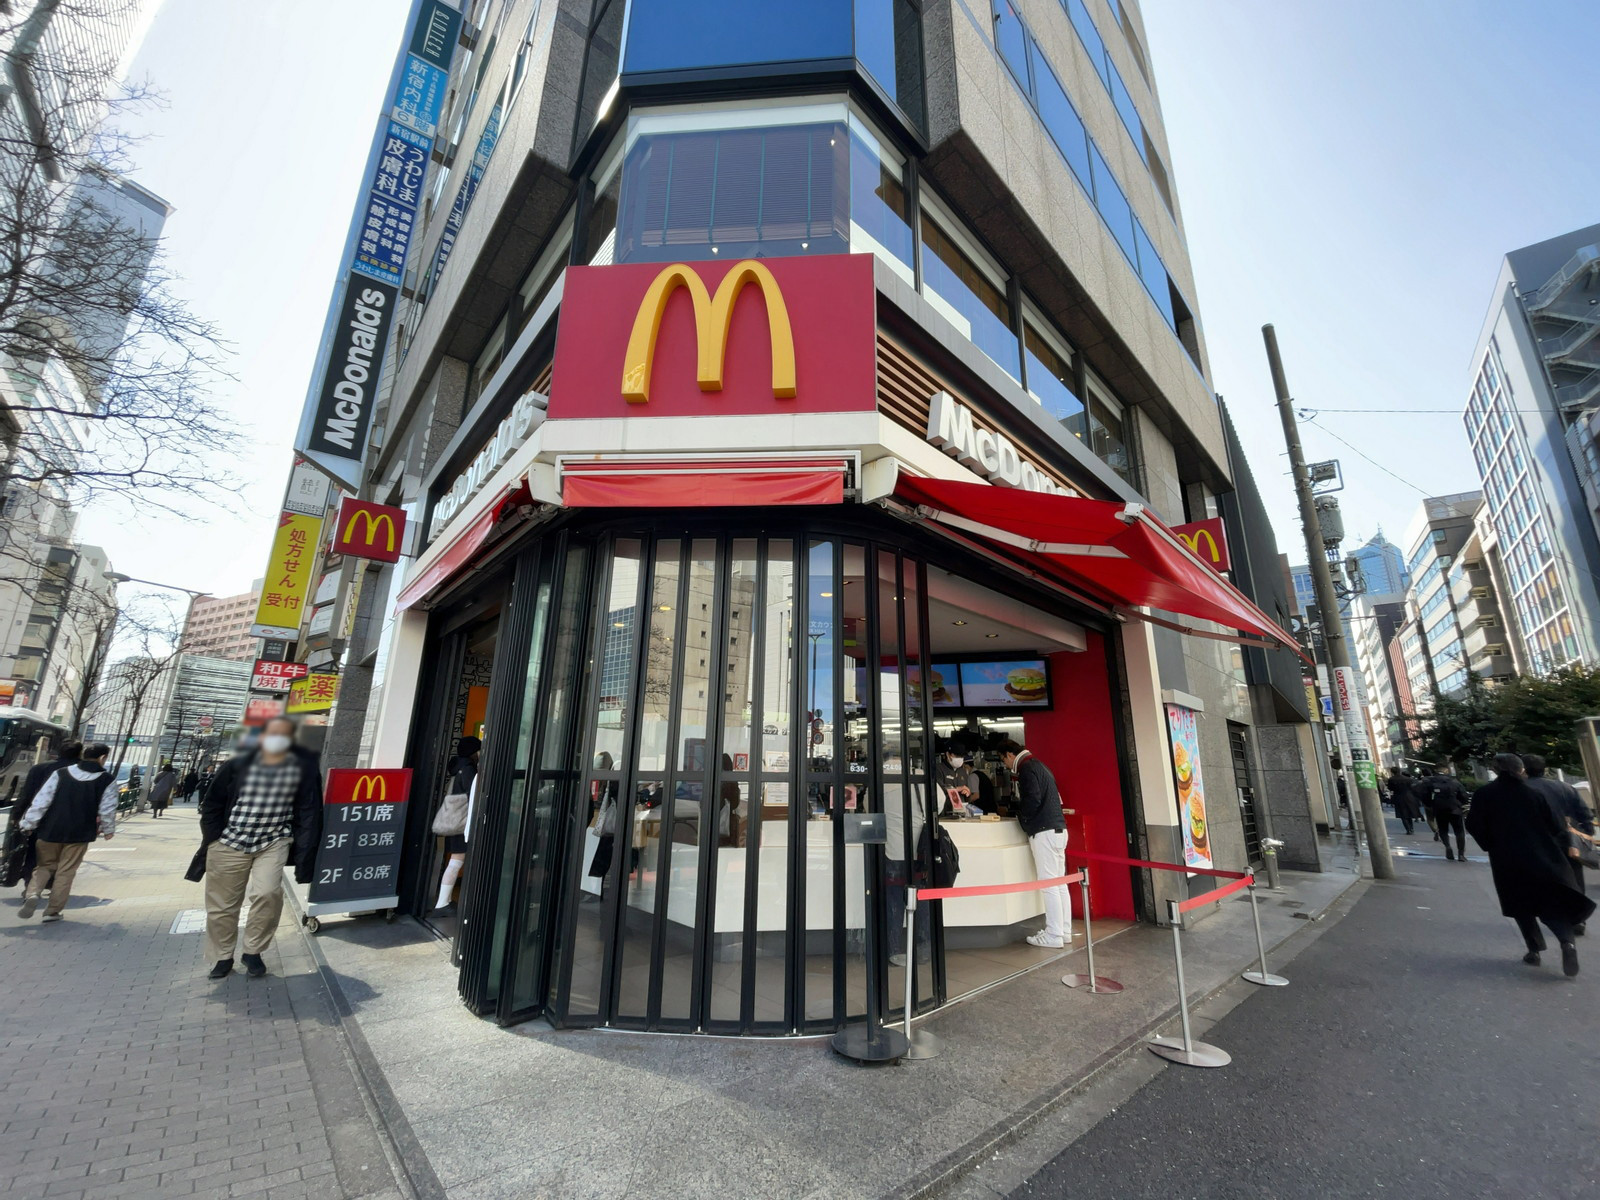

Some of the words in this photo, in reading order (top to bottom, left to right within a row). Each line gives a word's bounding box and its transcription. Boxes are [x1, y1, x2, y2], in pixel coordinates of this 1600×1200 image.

[425, 9, 450, 58] BIOTECH
[400, 60, 428, 115] 新宿内科
[391, 123, 429, 149] 新宿駅前
[377, 138, 407, 196] 皮膚科
[399, 147, 424, 203] うわじま
[361, 198, 387, 255] 一般皮膚科
[380, 206, 400, 249] 形成外科
[390, 211, 412, 265] 美容皮膚科
[324, 288, 386, 450] McDonald's
[279, 528, 307, 588] 処方せん
[265, 593, 300, 610] 受付
[259, 662, 306, 677] 和牛
[308, 675, 337, 699] 薬
[340, 803, 395, 822] 151席
[325, 833, 349, 849] 3F
[357, 832, 395, 847] 83席
[319, 868, 343, 884] 2F
[352, 865, 391, 880] 68席
